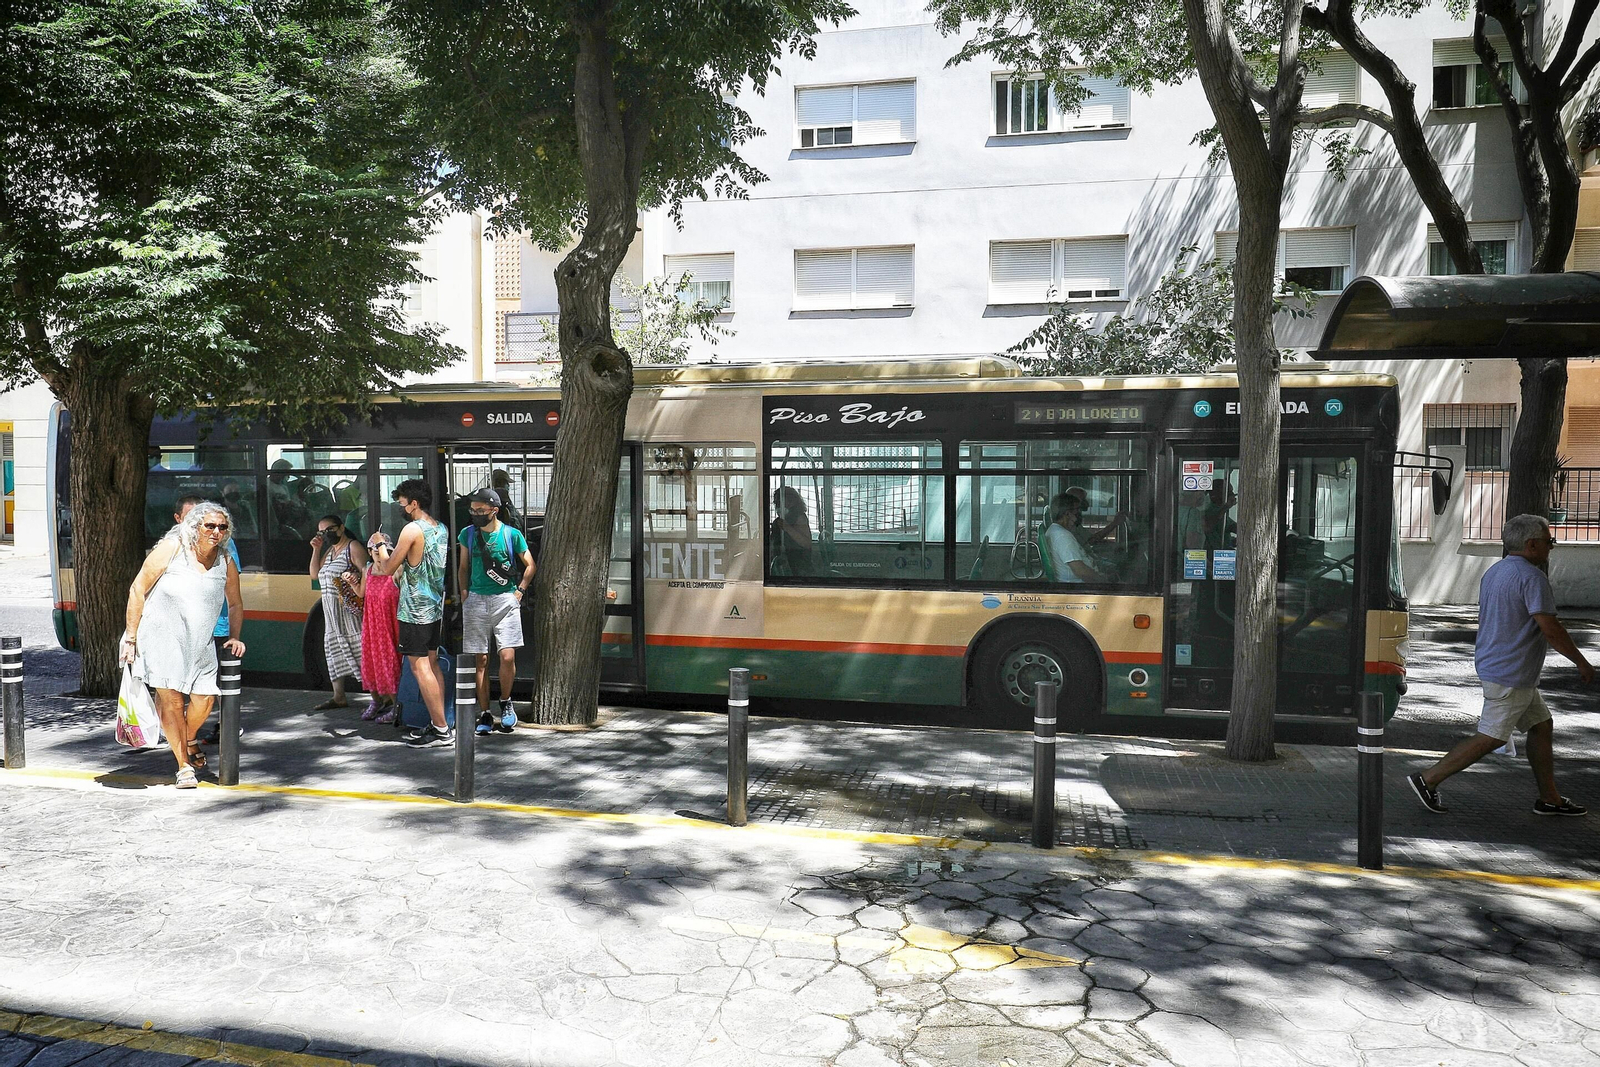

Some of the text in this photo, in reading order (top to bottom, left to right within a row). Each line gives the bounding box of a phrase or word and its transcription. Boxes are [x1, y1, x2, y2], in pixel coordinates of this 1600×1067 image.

[486, 412, 534, 424] SALIDA
[769, 402, 927, 429] Piso Bajo
[1081, 407, 1139, 419] LORETO
[667, 581, 686, 589] ACEPTA
